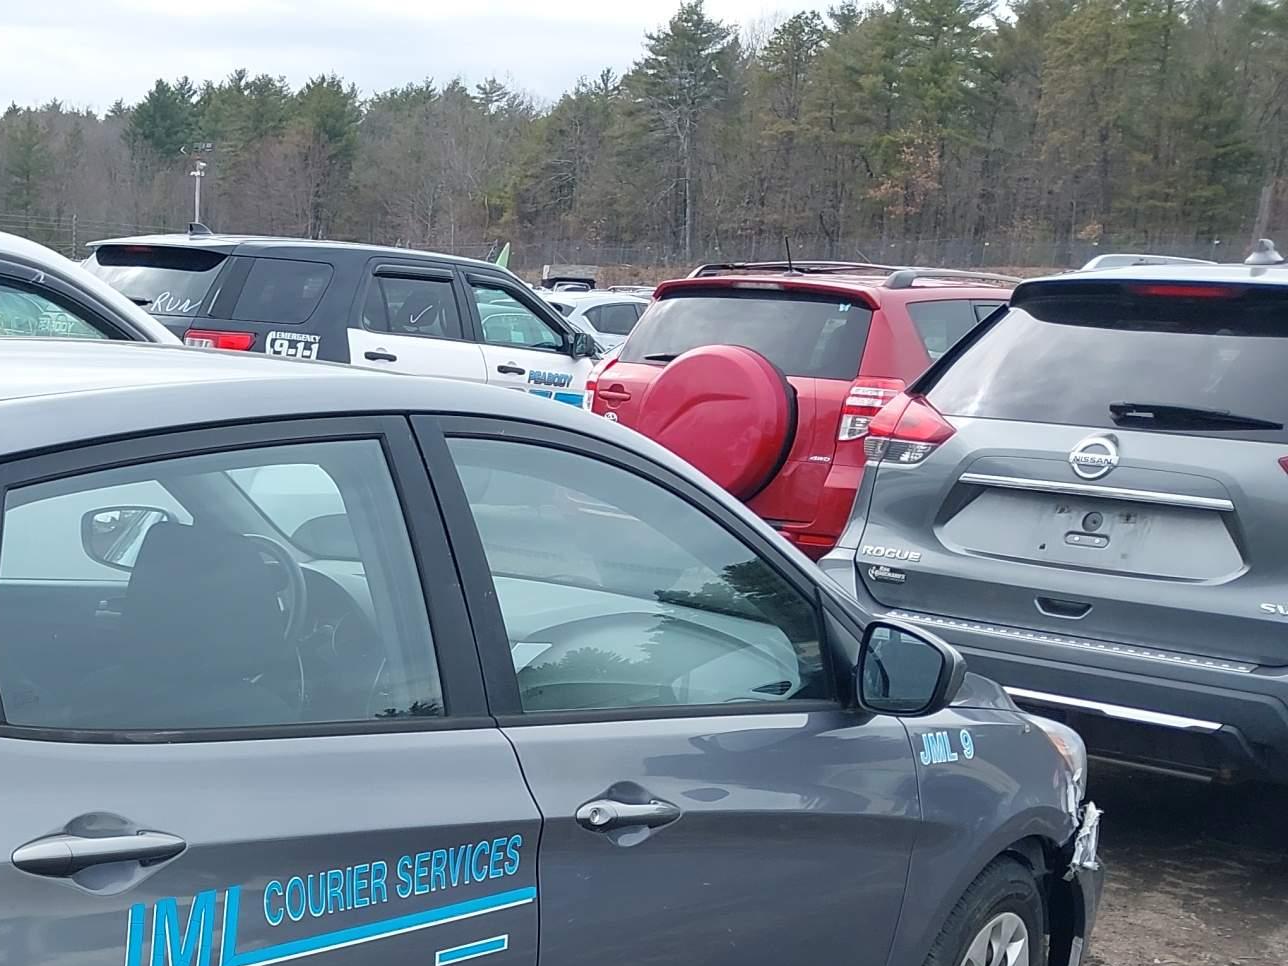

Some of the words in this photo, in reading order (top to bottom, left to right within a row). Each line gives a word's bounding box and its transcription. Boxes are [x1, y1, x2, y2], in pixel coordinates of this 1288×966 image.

[276, 332, 320, 343] EMERGENCY
[528, 369, 573, 388] PEABODY
[1073, 456, 1113, 465] NISSAN
[862, 545, 921, 562] ROGUE
[920, 731, 959, 765] JML
[959, 729, 974, 760] 9
[263, 860, 388, 927] COURIER
[396, 834, 522, 899] SERVICES
